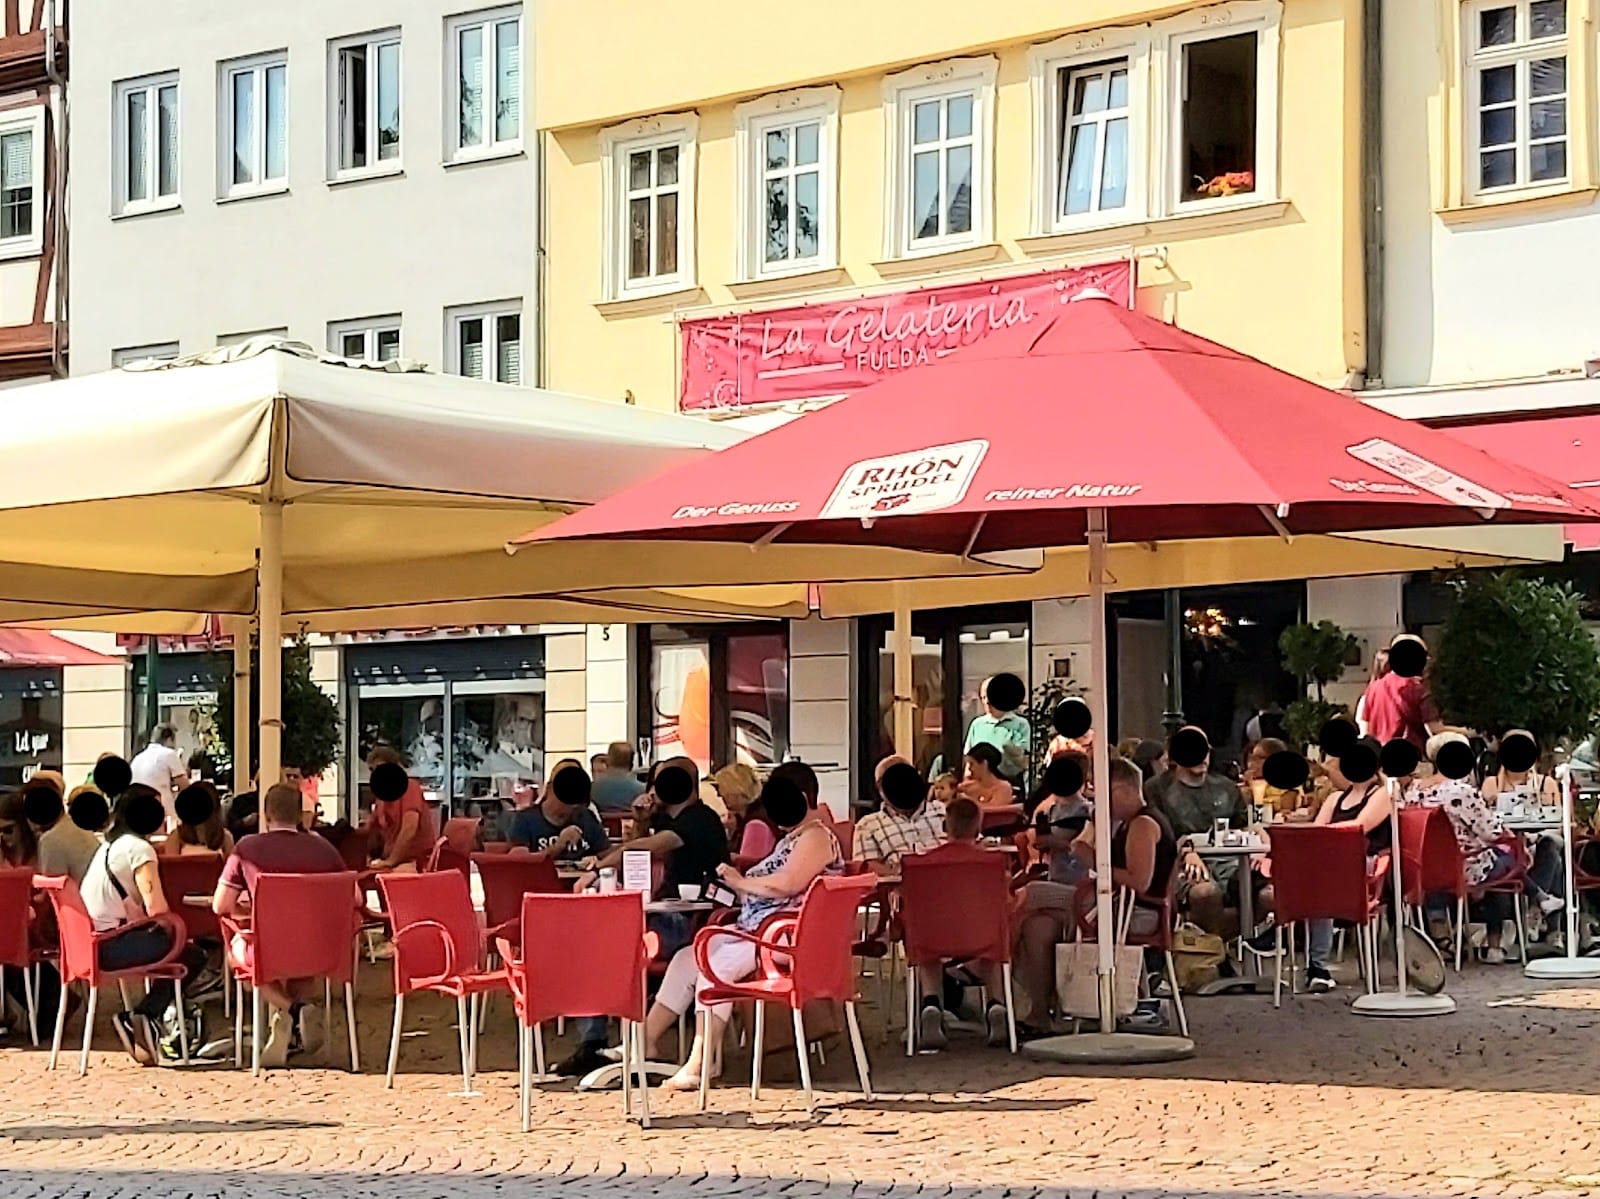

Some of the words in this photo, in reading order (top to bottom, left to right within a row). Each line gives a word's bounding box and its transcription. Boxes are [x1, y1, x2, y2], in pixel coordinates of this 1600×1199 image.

[762, 318, 812, 360] La
[826, 286, 1034, 351] Gelateria
[857, 346, 929, 372] FULDA
[857, 454, 965, 486] RHÖN
[850, 472, 956, 498] SPRUDEL
[984, 486, 1065, 501] reiner
[1064, 483, 1143, 498] Natur
[672, 504, 718, 519] Der
[718, 501, 801, 516] Genuss
[602, 626, 610, 641] 5
